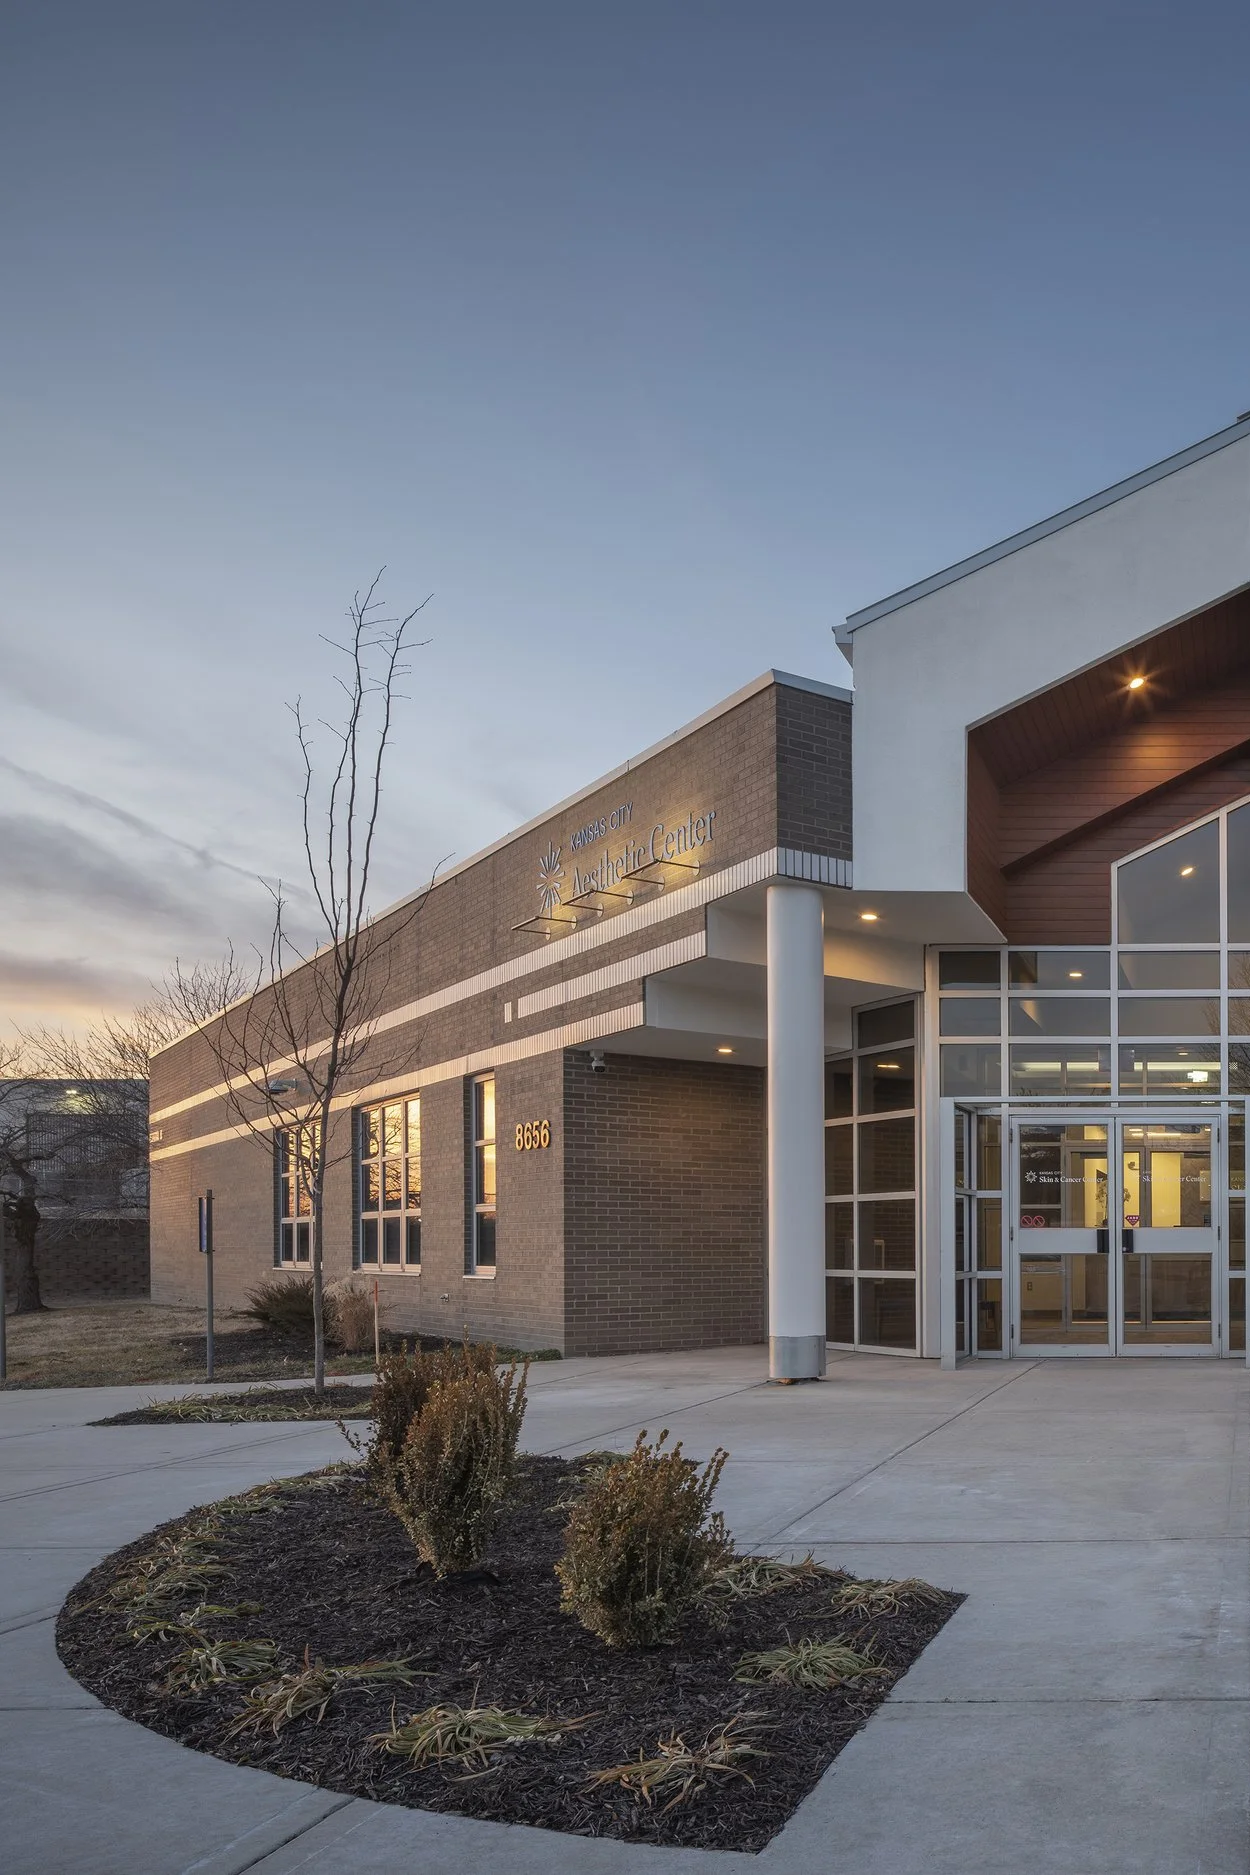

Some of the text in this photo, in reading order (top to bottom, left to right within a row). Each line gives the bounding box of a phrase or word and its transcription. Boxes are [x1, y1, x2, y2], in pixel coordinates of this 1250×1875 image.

[570, 801, 634, 852] KANSAS CITY
[573, 809, 717, 899] Aesthetic Center
[515, 1119, 551, 1151] 8656
